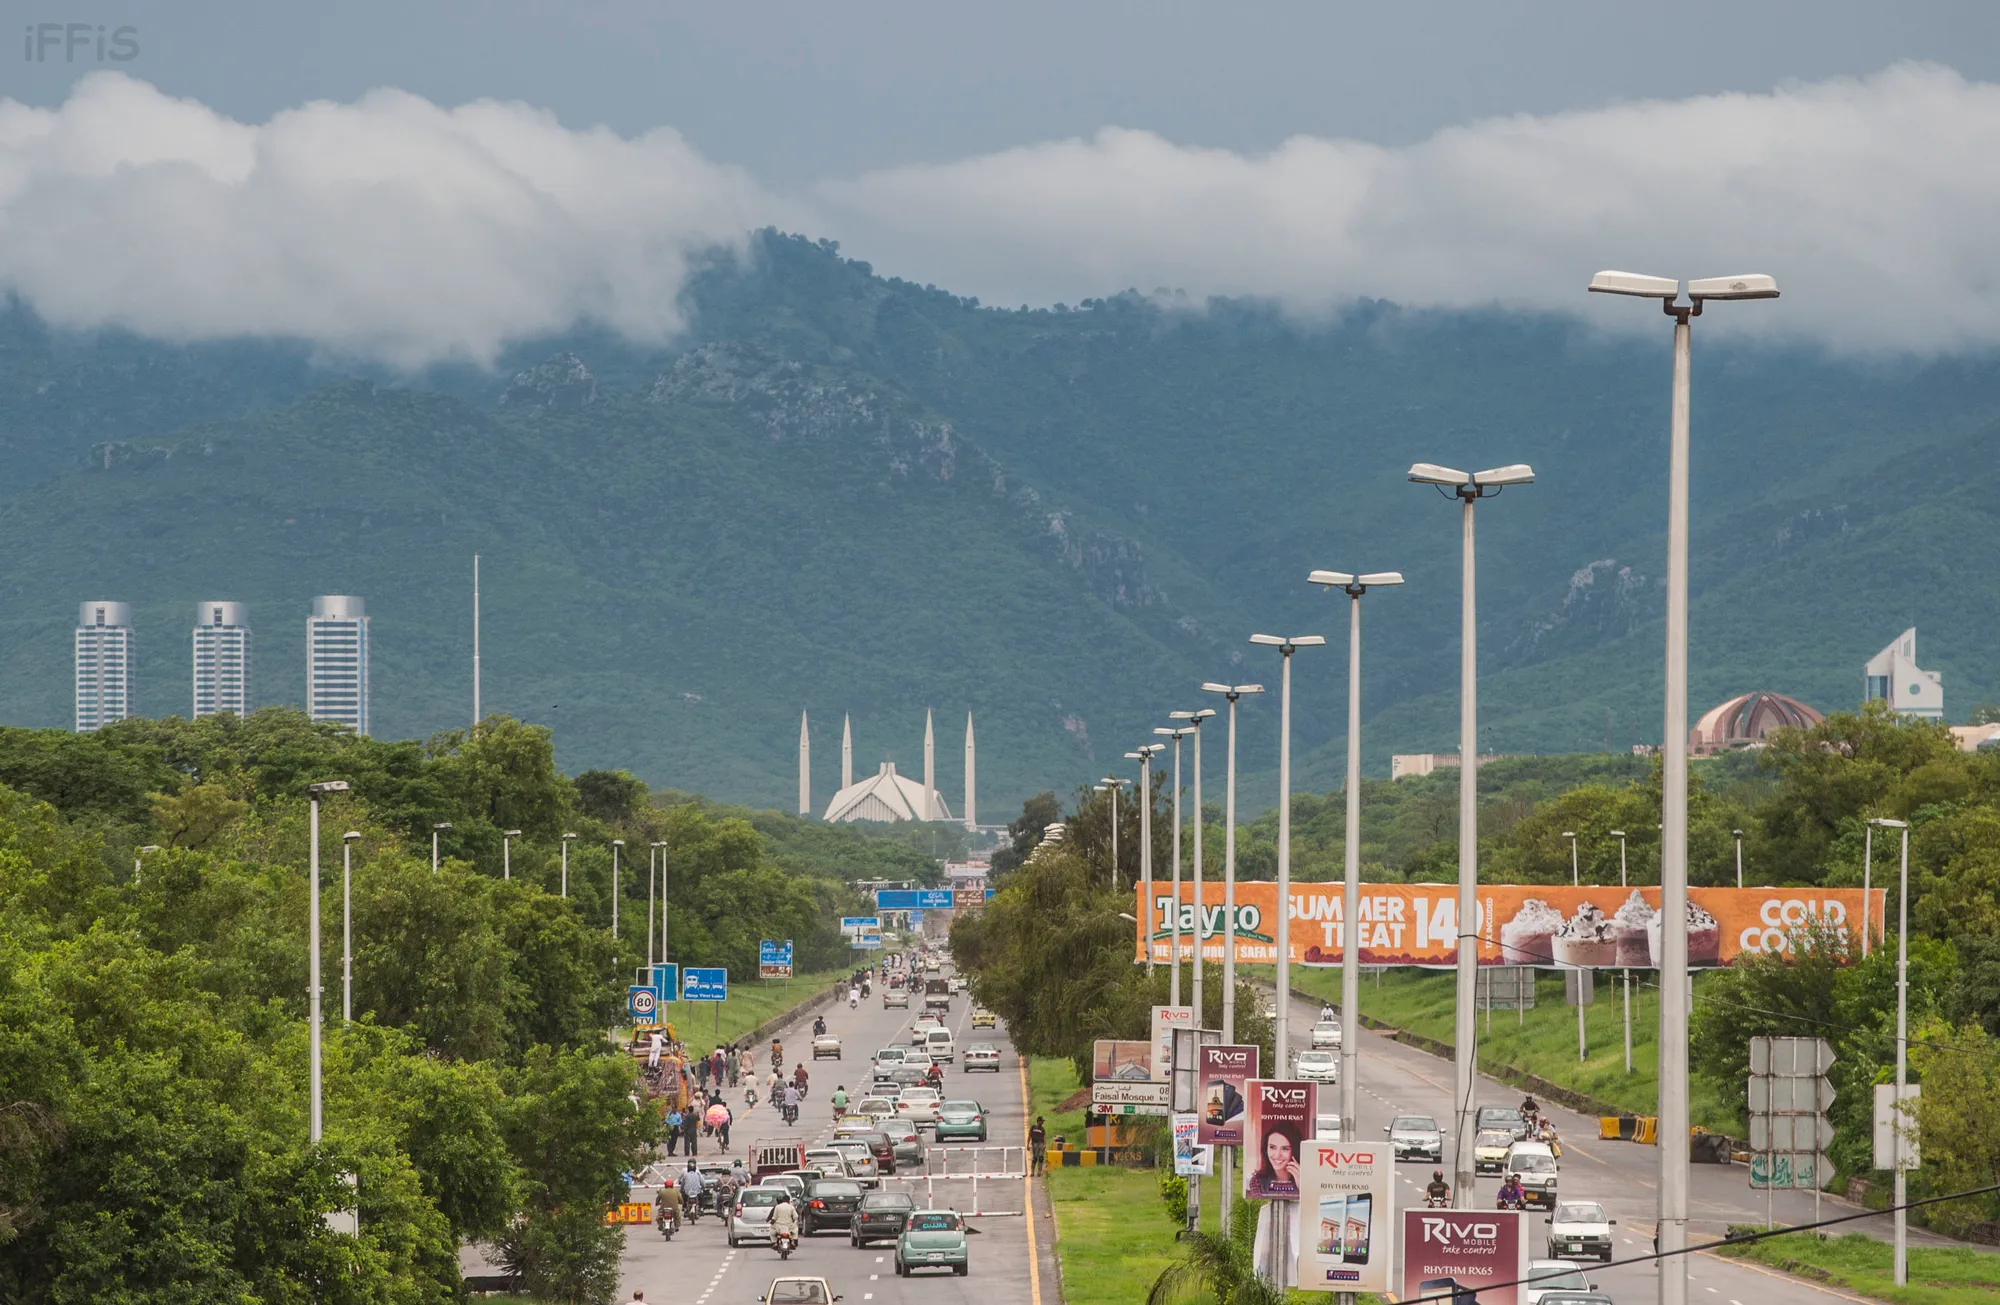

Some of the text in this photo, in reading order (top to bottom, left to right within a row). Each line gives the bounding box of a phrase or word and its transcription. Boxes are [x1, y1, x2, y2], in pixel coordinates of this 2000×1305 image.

[637, 998, 651, 1007] 80
[1208, 1049, 1247, 1063] RIVO
[1095, 1092, 1154, 1102] Faisal Mosque
[1260, 1086, 1306, 1103] RIVO
[1098, 1105, 1113, 1114] 3M
[1318, 1149, 1374, 1168] RIVO
[1421, 1217, 1498, 1244] RIVO
[1442, 1245, 1497, 1255] take control
[1424, 1265, 1493, 1276] RHYTHM RX65
